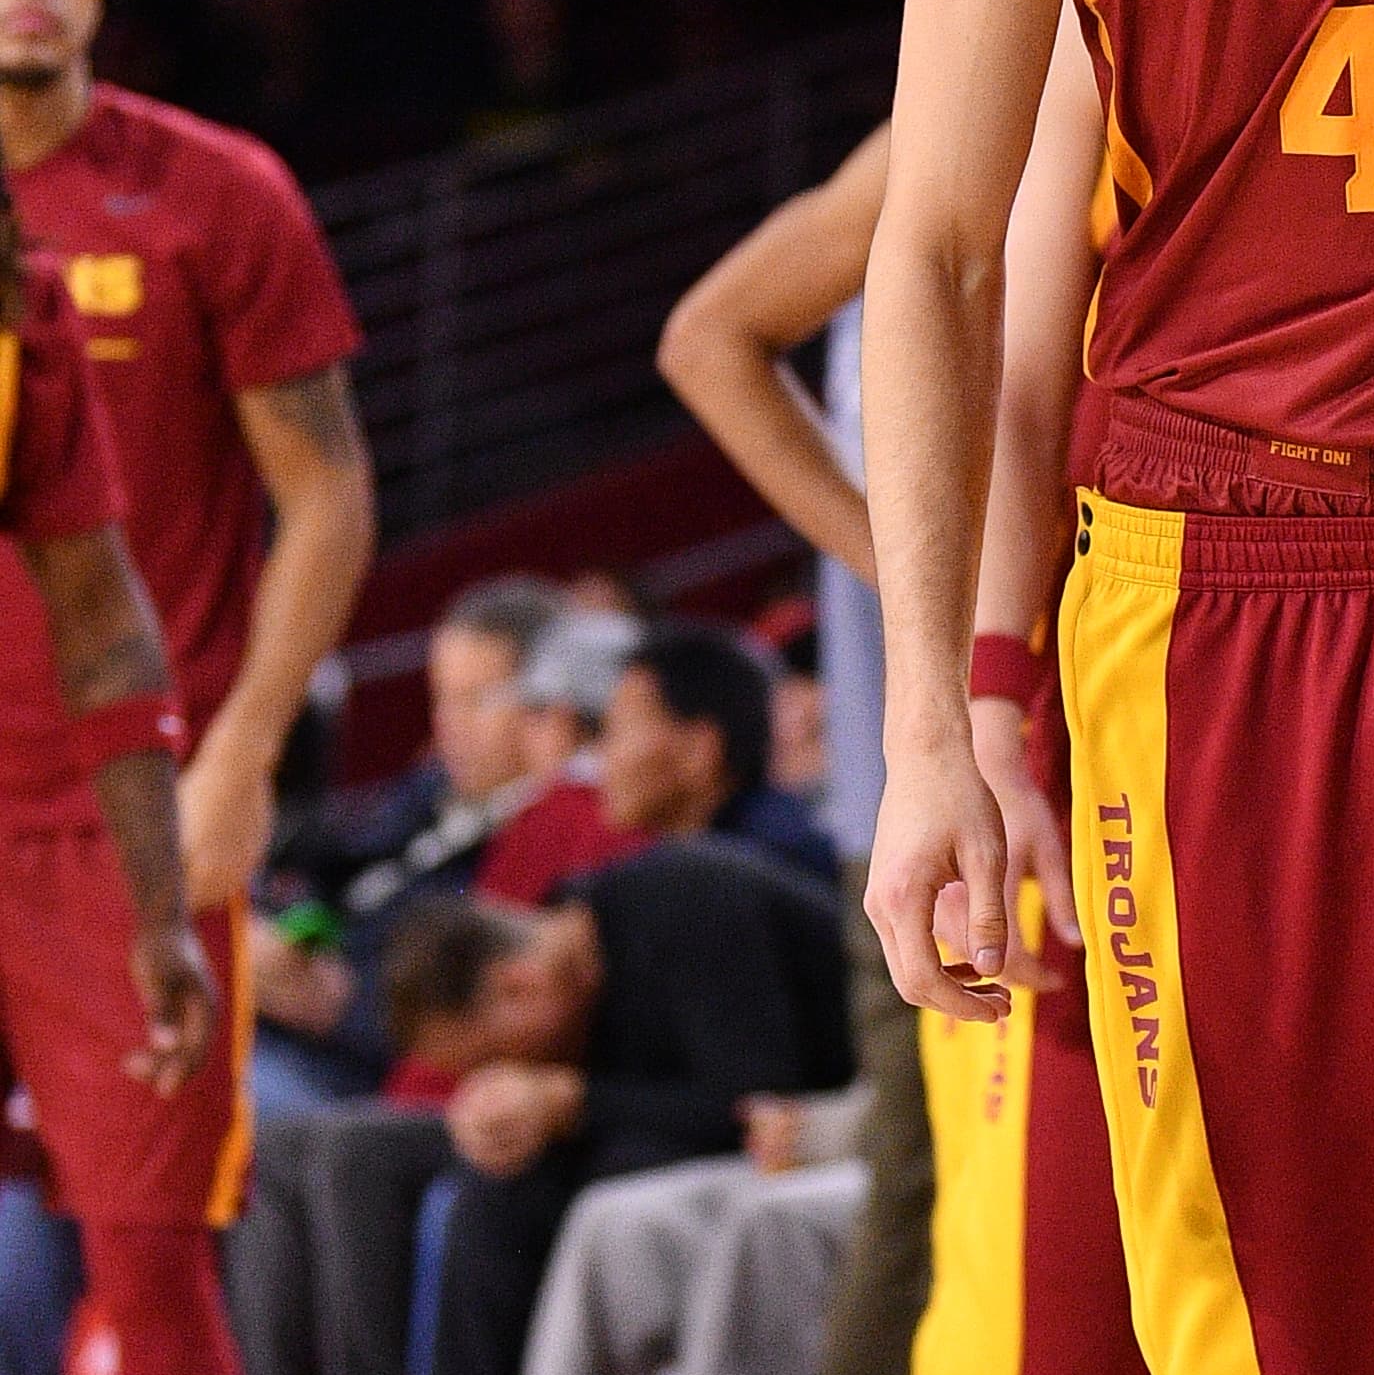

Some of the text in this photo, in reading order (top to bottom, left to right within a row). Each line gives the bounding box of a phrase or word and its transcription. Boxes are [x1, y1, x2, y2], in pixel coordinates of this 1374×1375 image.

[1270, 440, 1351, 466] FIGHT ON!
[1098, 792, 1160, 1110] TROJANS
